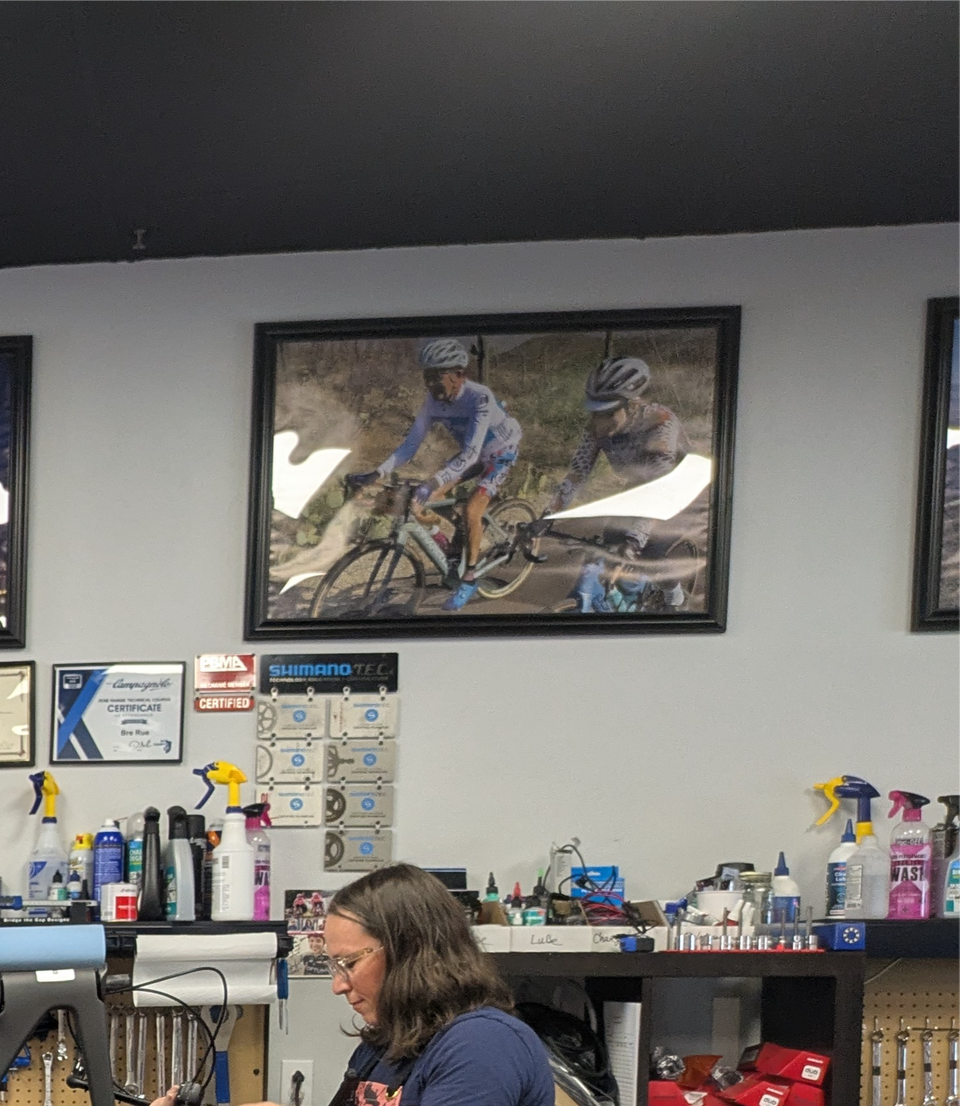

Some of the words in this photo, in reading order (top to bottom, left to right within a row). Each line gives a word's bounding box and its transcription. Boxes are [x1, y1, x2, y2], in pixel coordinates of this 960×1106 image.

[269, 663, 352, 677] SHIMANO
[107, 704, 162, 713] CERTIFICATE
[199, 698, 250, 709] CERTIFIED
